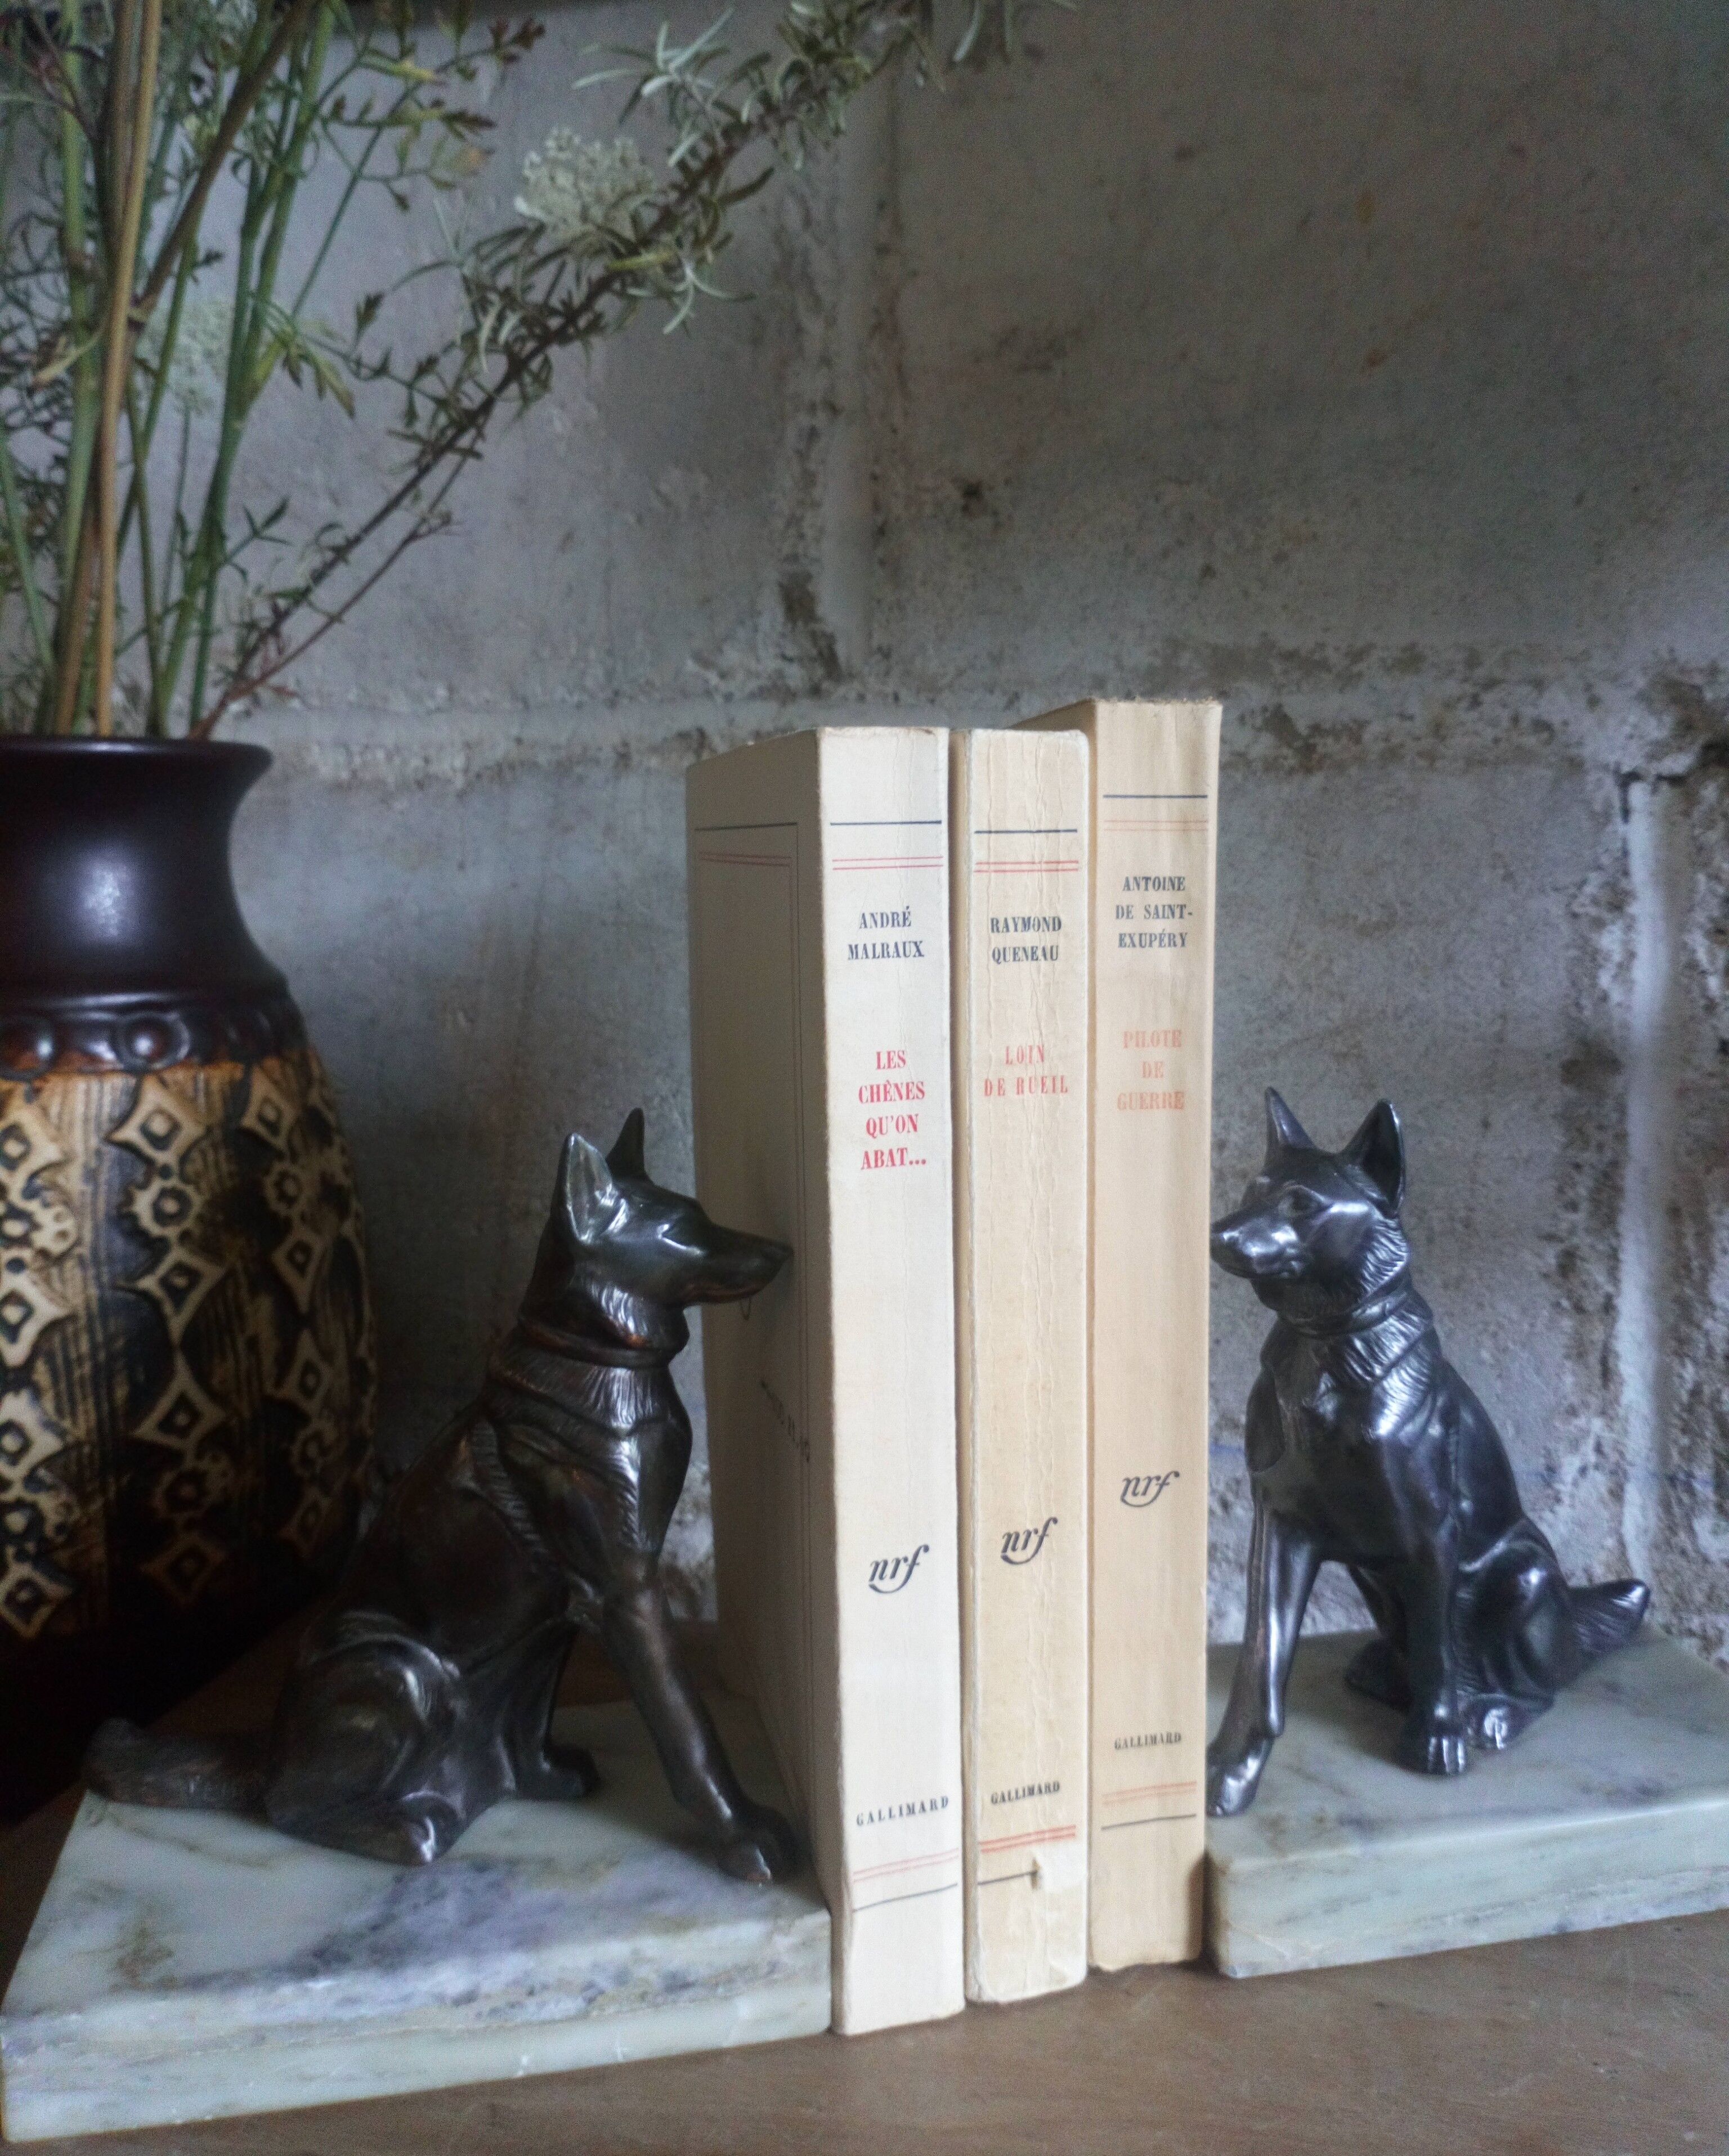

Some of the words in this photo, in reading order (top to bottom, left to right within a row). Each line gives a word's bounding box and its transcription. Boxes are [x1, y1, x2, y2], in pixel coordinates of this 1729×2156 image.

[1123, 876, 1186, 891] ANTOINE
[859, 905, 912, 929] ANDRÉ
[1116, 904, 1134, 920] DE
[1144, 904, 1193, 920] SAINT-
[991, 916, 1062, 934] RAYMOND
[1118, 928, 1189, 949] EXUPÉRY
[848, 940, 925, 960] MALRAUX
[992, 945, 1059, 965] QUENEAU
[1123, 1030, 1182, 1048] PILOTE
[876, 1051, 907, 1069] LES
[1005, 1045, 1045, 1065] LOIN
[1141, 1061, 1165, 1079] DE
[858, 1080, 926, 1104] CHÊNES
[984, 1077, 1006, 1097] DE
[1015, 1075, 1068, 1096] RUEIL
[1117, 1091, 1185, 1111] GUERRE
[866, 1114, 919, 1139] QU'ON
[861, 1148, 927, 1169] ABAT...
[1120, 1470, 1181, 1508] nrf
[1000, 1517, 1059, 1566] nrf
[869, 1544, 930, 1594] nrf
[1114, 1732, 1182, 1750] GALLIMARD
[991, 1781, 1061, 1805] GALLIMARD
[856, 1796, 949, 1826] GALLIMARD
